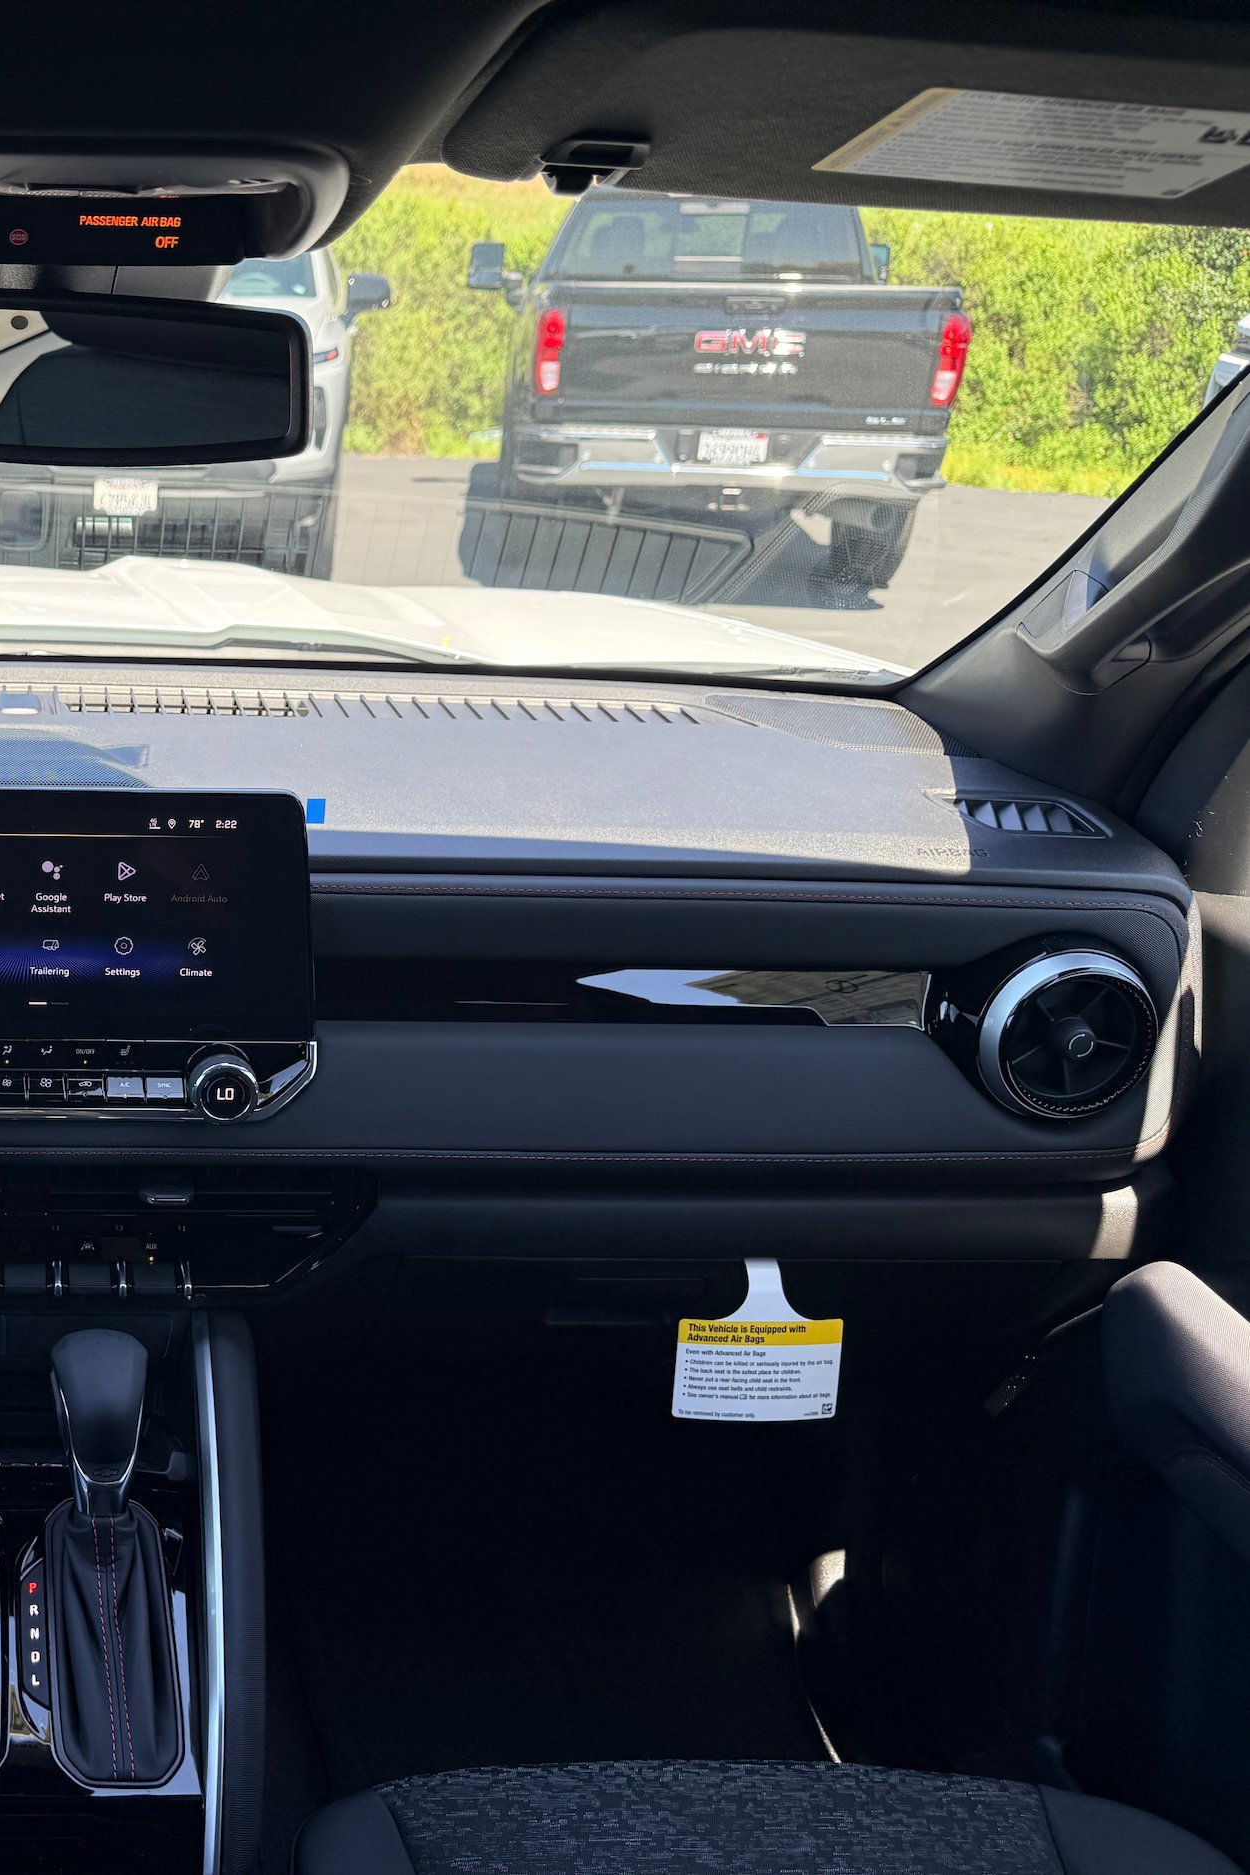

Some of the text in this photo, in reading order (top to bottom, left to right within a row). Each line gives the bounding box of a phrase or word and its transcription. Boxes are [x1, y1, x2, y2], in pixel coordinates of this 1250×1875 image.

[79, 215, 182, 227] PASSENGER AIR BAG
[155, 236, 179, 248] OFF
[215, 819, 237, 829] 2:22
[35, 892, 68, 903] Google
[104, 893, 147, 904] Play Store
[171, 893, 228, 903] Android Auto
[31, 904, 72, 914] Assistant
[29, 966, 70, 978] Trailering
[104, 967, 141, 978] Settings
[179, 967, 213, 977] Climate
[216, 1087, 235, 1101] LO
[689, 1324, 706, 1332] This
[709, 1325, 738, 1333] Vehicle
[750, 1325, 786, 1335] Equipped
[687, 1333, 728, 1342] Advanced
[745, 1336, 764, 1344] Bags
[28, 1582, 38, 1593] P
[29, 1604, 39, 1616] R
[30, 1628, 40, 1640] N
[31, 1651, 41, 1664] D
[31, 1674, 40, 1686] L
